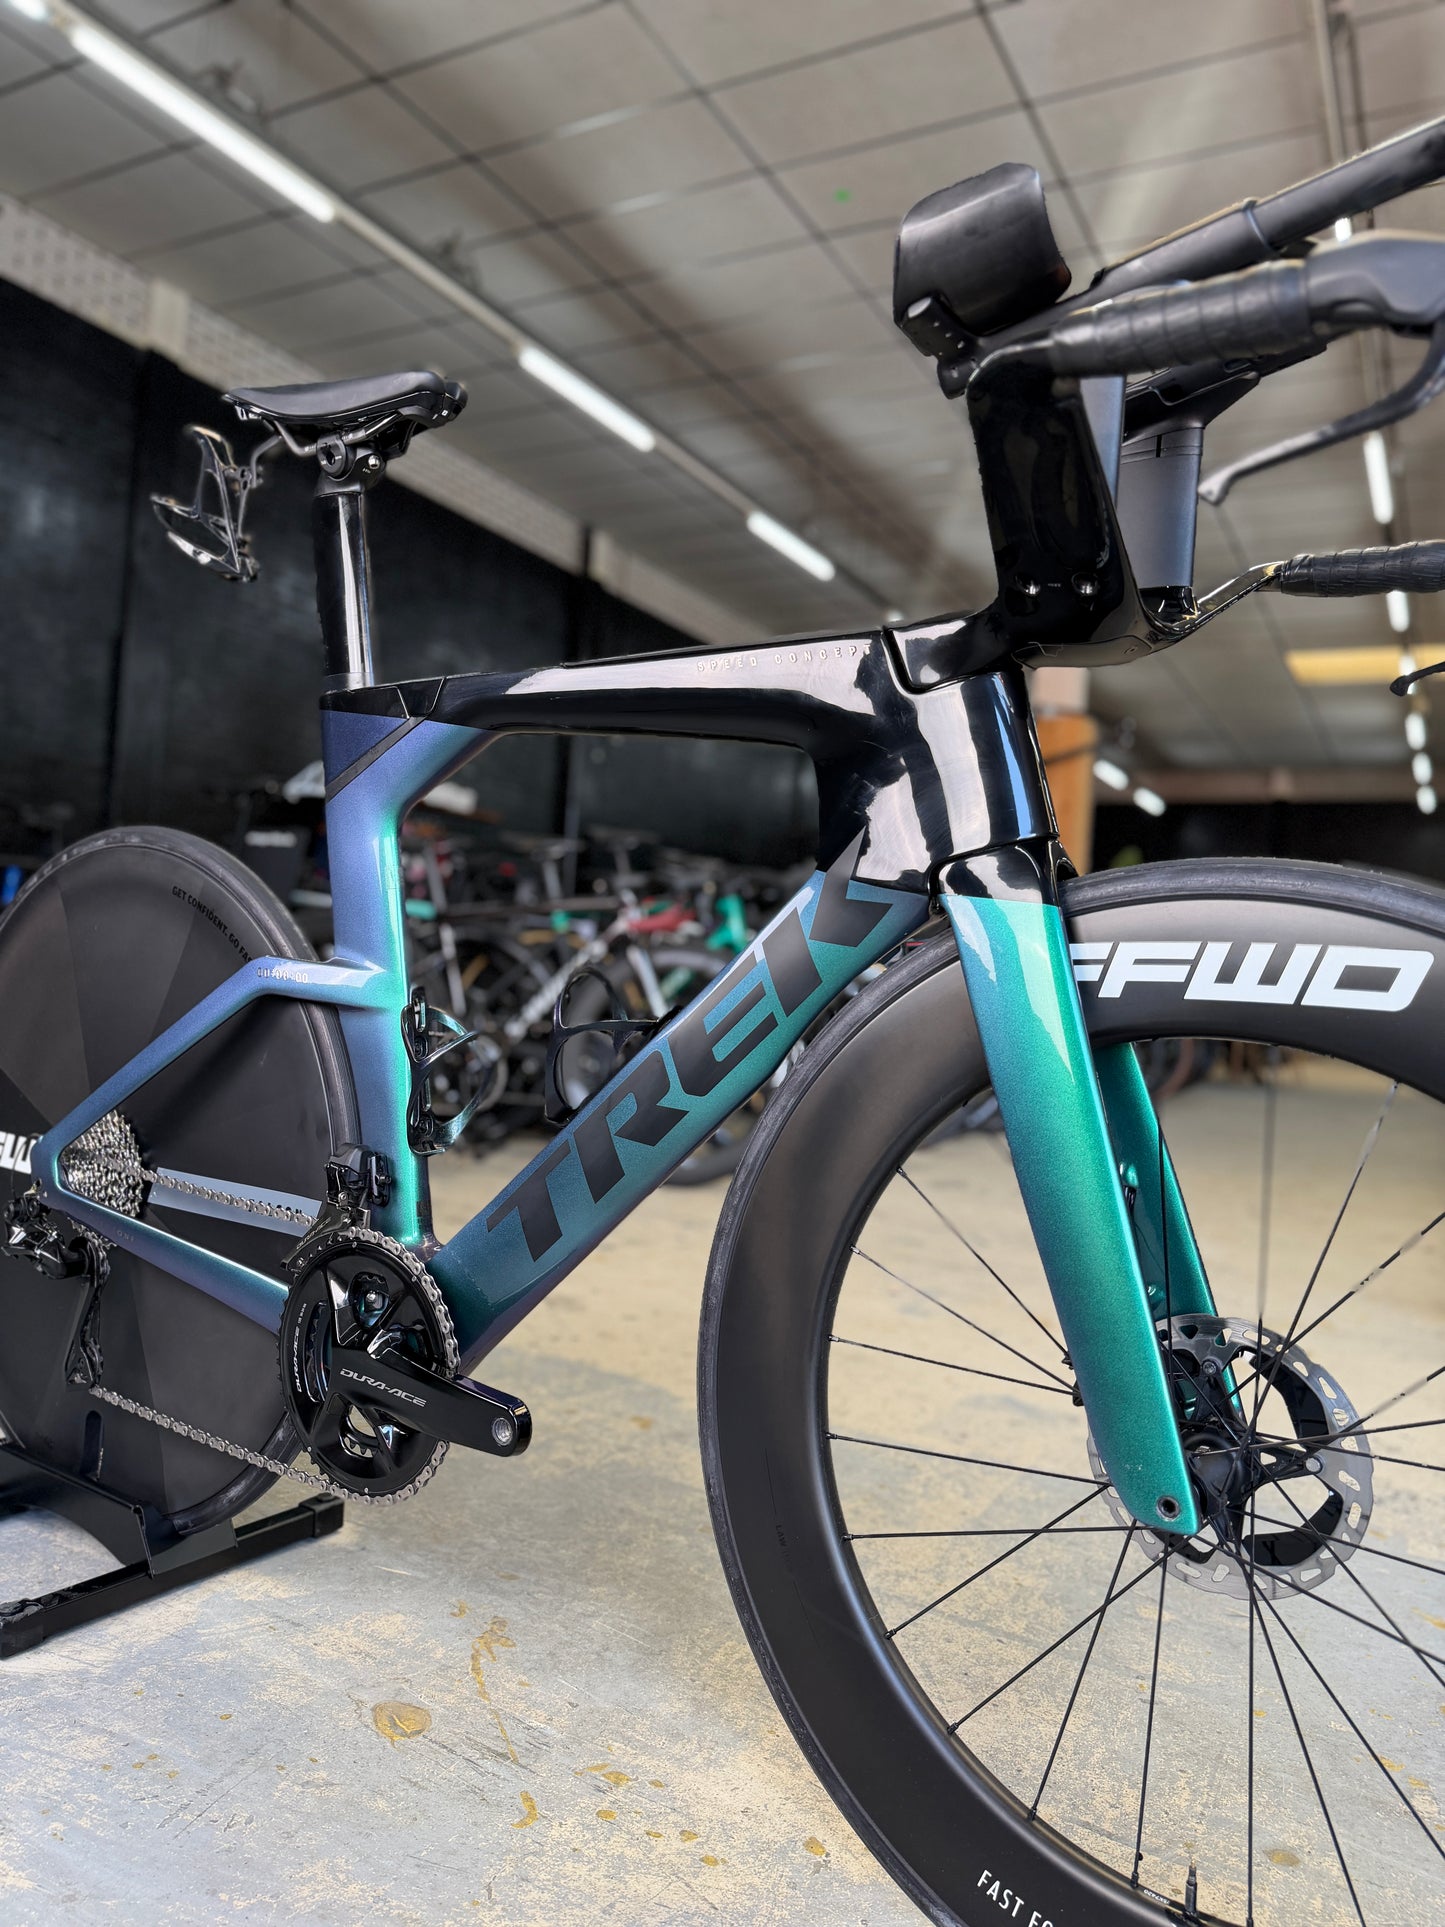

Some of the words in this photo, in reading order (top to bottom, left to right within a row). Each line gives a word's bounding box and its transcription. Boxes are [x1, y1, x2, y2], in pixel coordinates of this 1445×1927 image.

[697, 657, 758, 672] SPEED
[774, 644, 871, 665] CONCEPT
[172, 886, 187, 901] GET
[228, 933, 240, 948] GO
[486, 825, 893, 1262] TREK
[340, 1368, 427, 1408] DURA-ACE
[977, 1869, 1025, 1918] FAST
